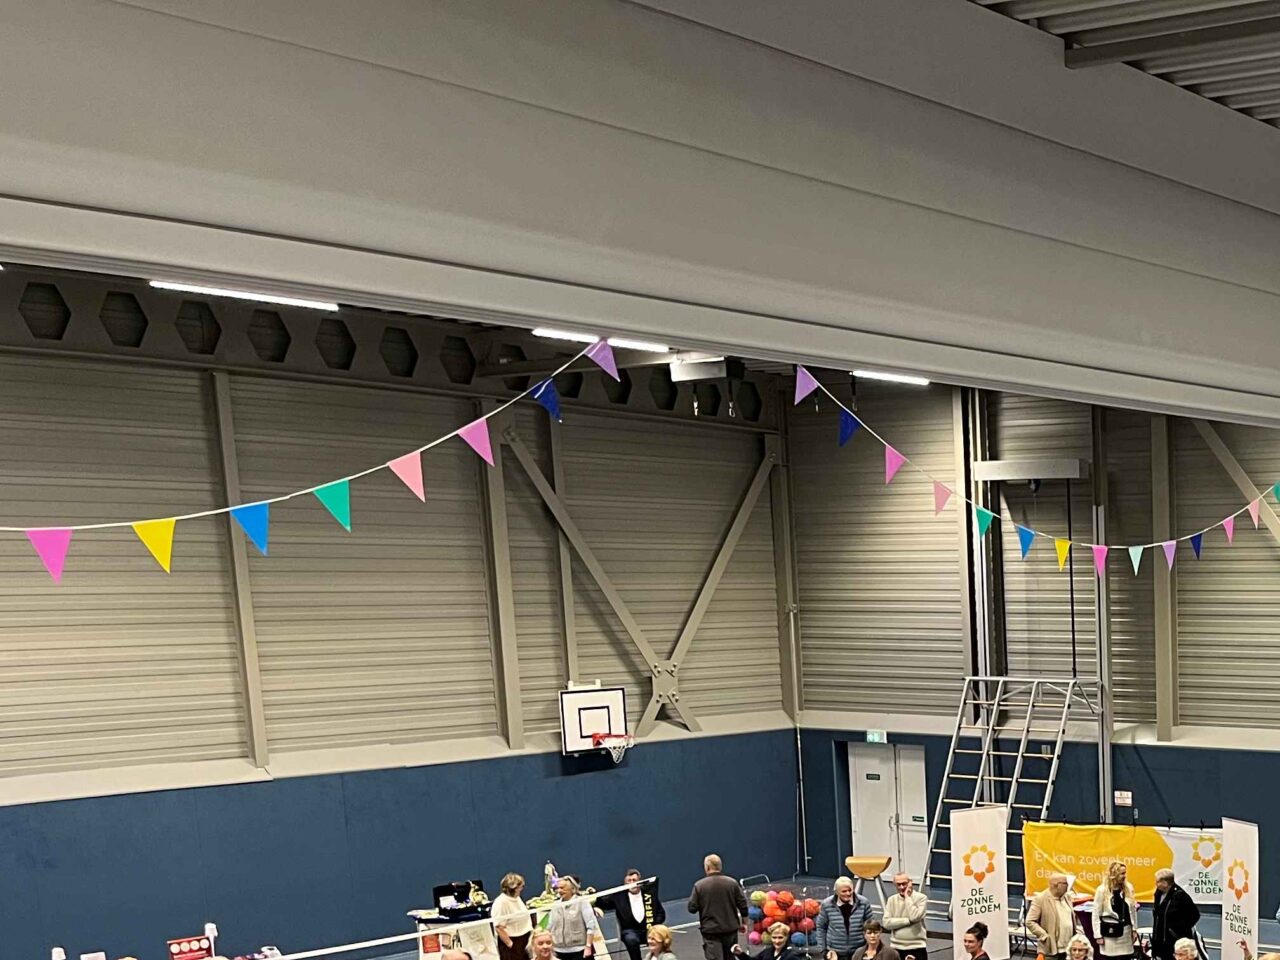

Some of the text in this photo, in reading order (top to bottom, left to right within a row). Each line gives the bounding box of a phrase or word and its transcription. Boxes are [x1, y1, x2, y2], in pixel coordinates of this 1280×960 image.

[1053, 852, 1075, 864] kan
[1124, 856, 1157, 867] meer
[1198, 871, 1210, 879] DE
[1188, 879, 1219, 887] ZONNE
[970, 887, 984, 897] DE
[960, 894, 994, 908] ZONNE
[967, 903, 1001, 916] BLOEM
[1232, 903, 1241, 915] DE
[1224, 911, 1248, 926] ZONNE
[1229, 922, 1252, 936] BLOEM
